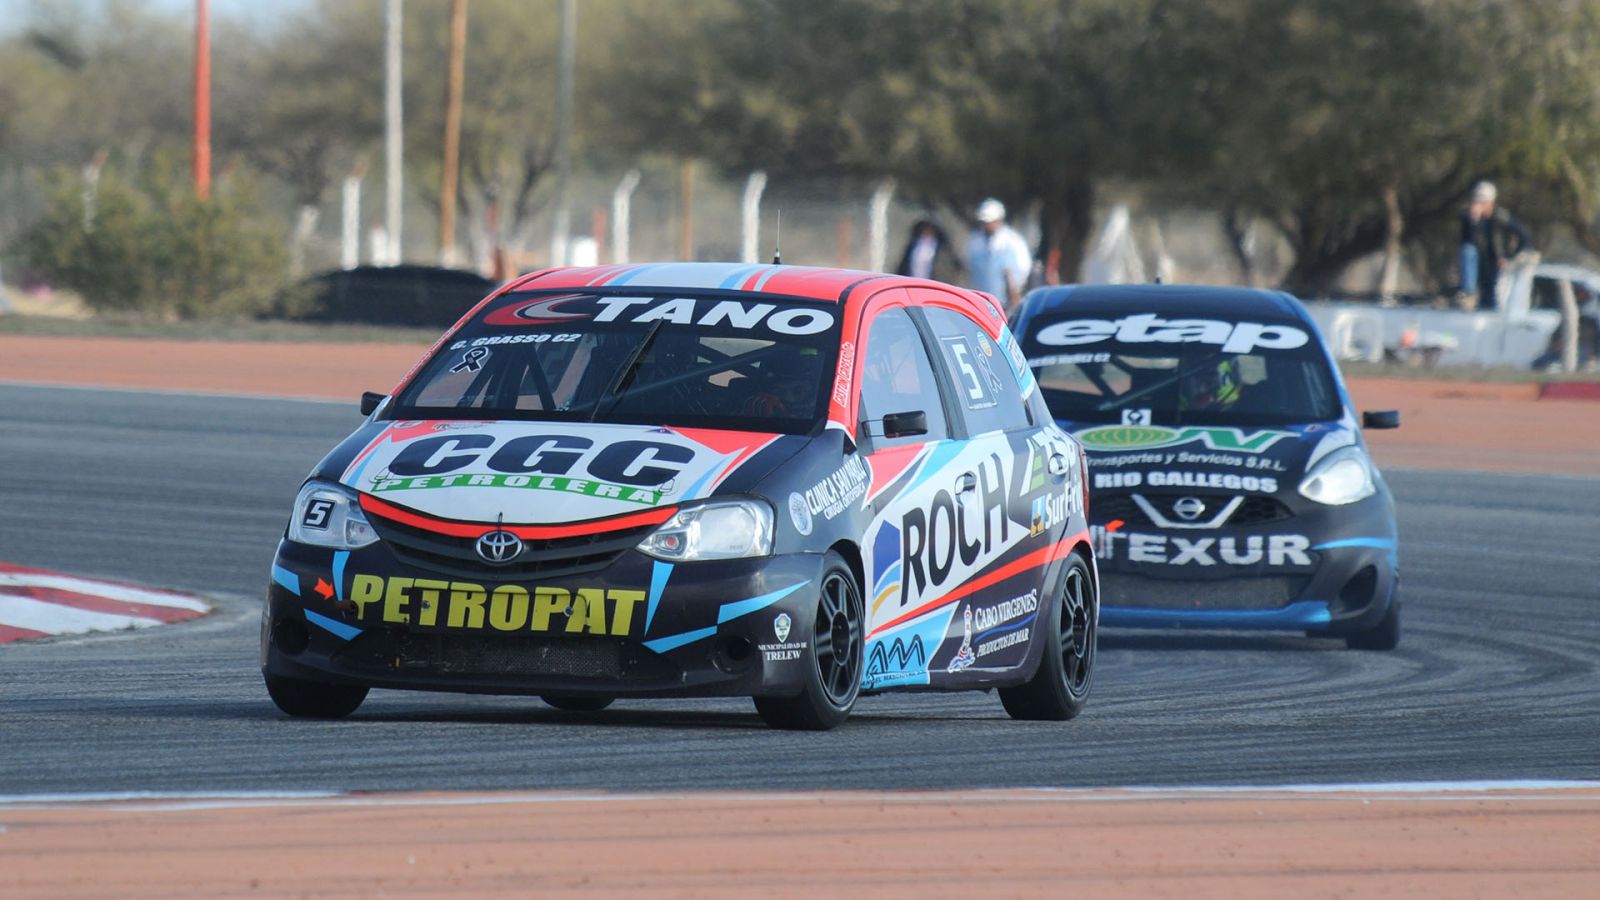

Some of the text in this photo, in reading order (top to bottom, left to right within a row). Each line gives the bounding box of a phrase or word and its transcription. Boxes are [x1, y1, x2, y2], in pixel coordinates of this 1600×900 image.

[472, 334, 552, 346] GRASSO
[552, 333, 582, 342] C2
[1036, 313, 1309, 354] etap
[952, 344, 984, 400] 5
[388, 434, 696, 486] CGC
[1178, 451, 1243, 466] Servicios
[376, 474, 656, 502] PETROLERA
[805, 477, 841, 516] CLINICA
[1095, 471, 1279, 493] RIO GALLEGOS
[305, 502, 331, 527] 5
[900, 452, 1009, 607] ROCH
[350, 574, 646, 636] PETROPAT
[975, 588, 1037, 630] CABO VIRGENES
[765, 650, 801, 660] TRELEW
